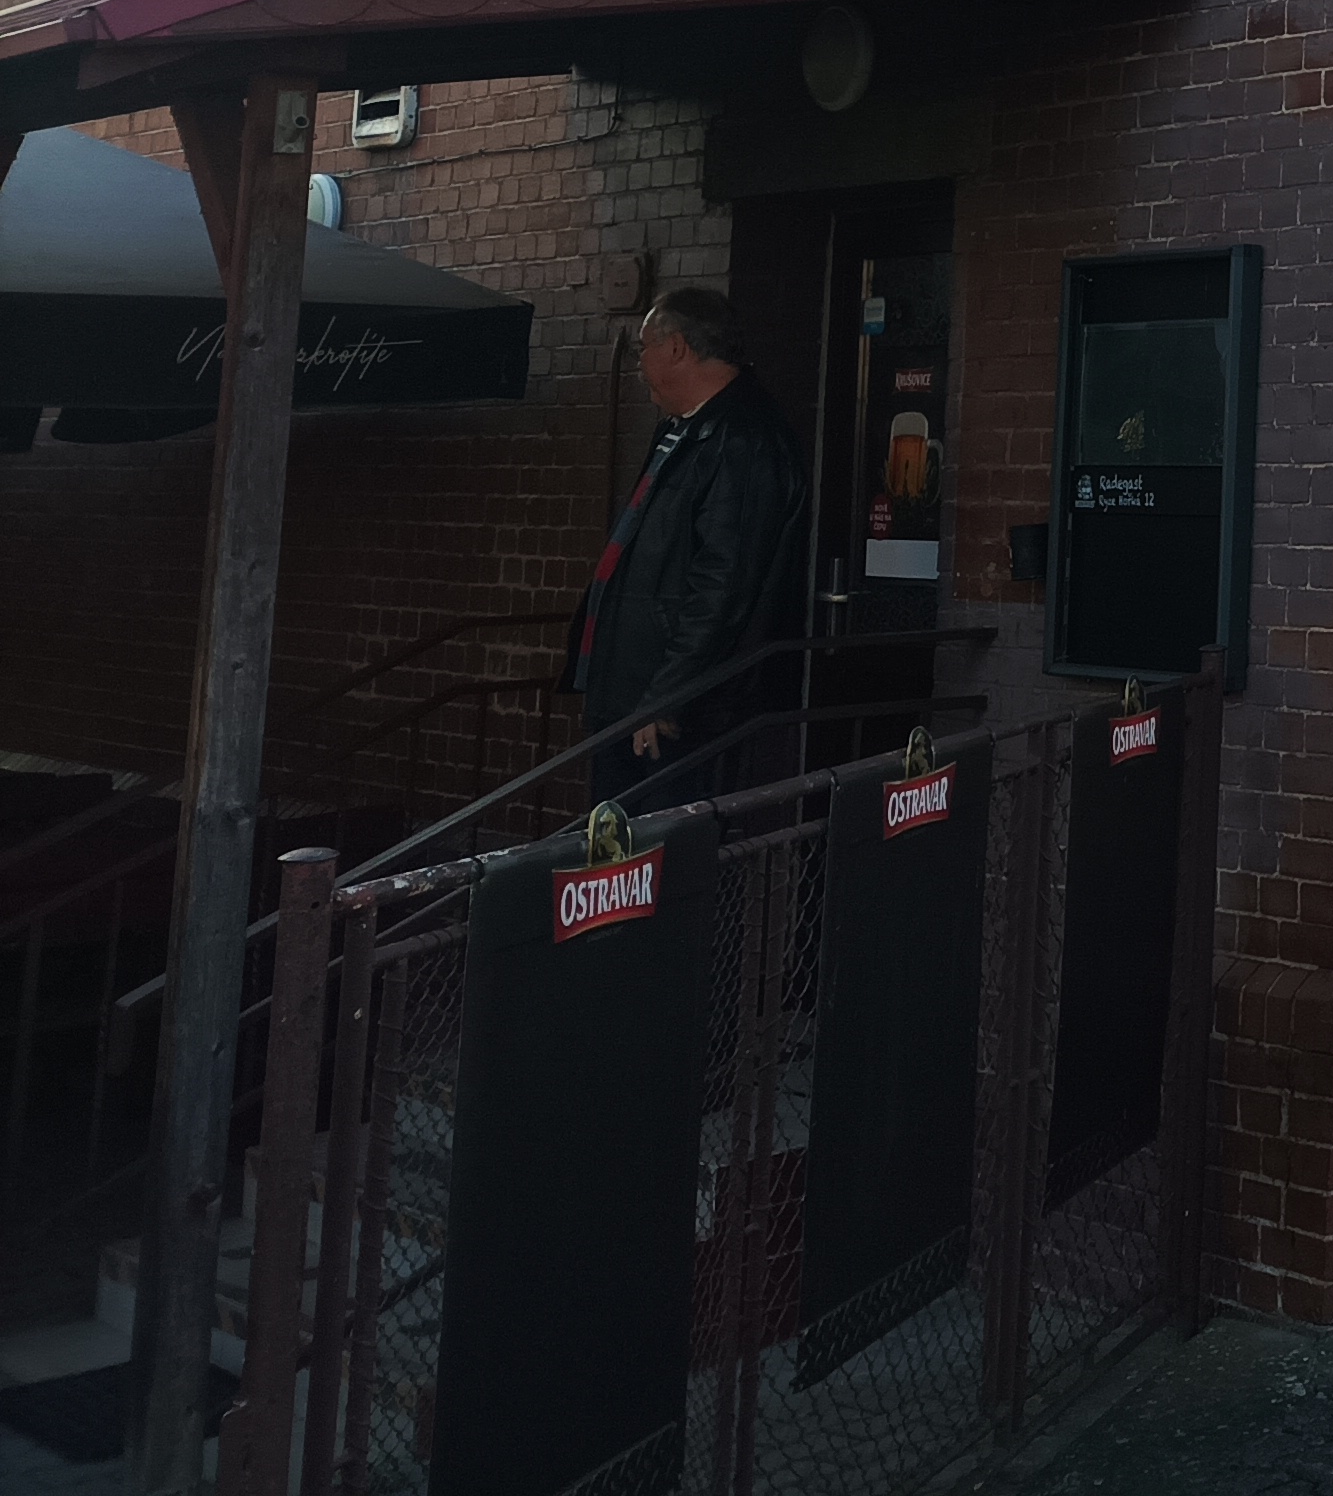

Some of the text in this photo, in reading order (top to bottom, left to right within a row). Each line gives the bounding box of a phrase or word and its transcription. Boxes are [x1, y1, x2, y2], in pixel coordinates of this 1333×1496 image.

[1099, 473, 1143, 495] Radegast
[1144, 492, 1155, 507] 12
[1112, 716, 1155, 758] OSTRAVAR
[887, 776, 947, 827] OSTRAVAR
[560, 862, 653, 927] OSTRAVAR
